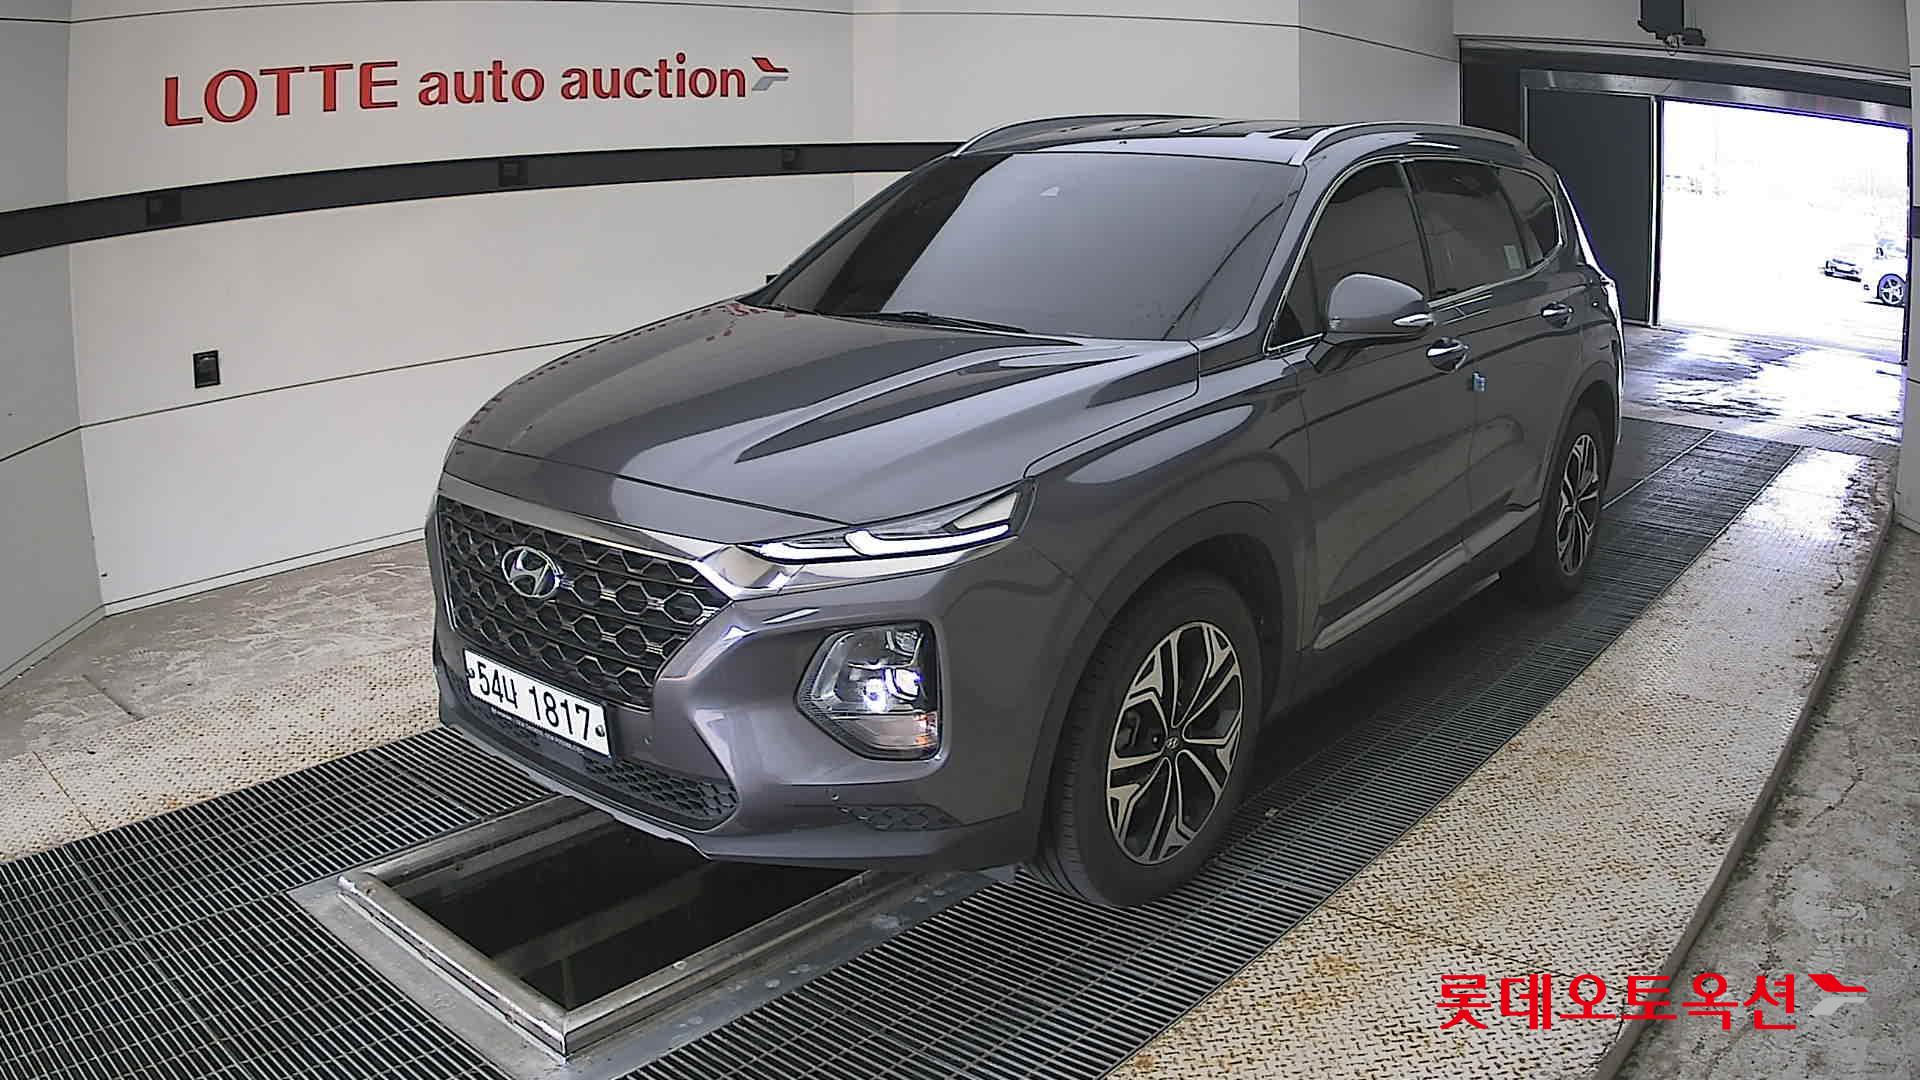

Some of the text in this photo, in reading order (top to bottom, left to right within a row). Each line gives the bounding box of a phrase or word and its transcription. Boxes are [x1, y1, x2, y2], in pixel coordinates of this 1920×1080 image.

[163, 52, 748, 127] LOTTE auto auction
[528, 685, 591, 741] 1817
